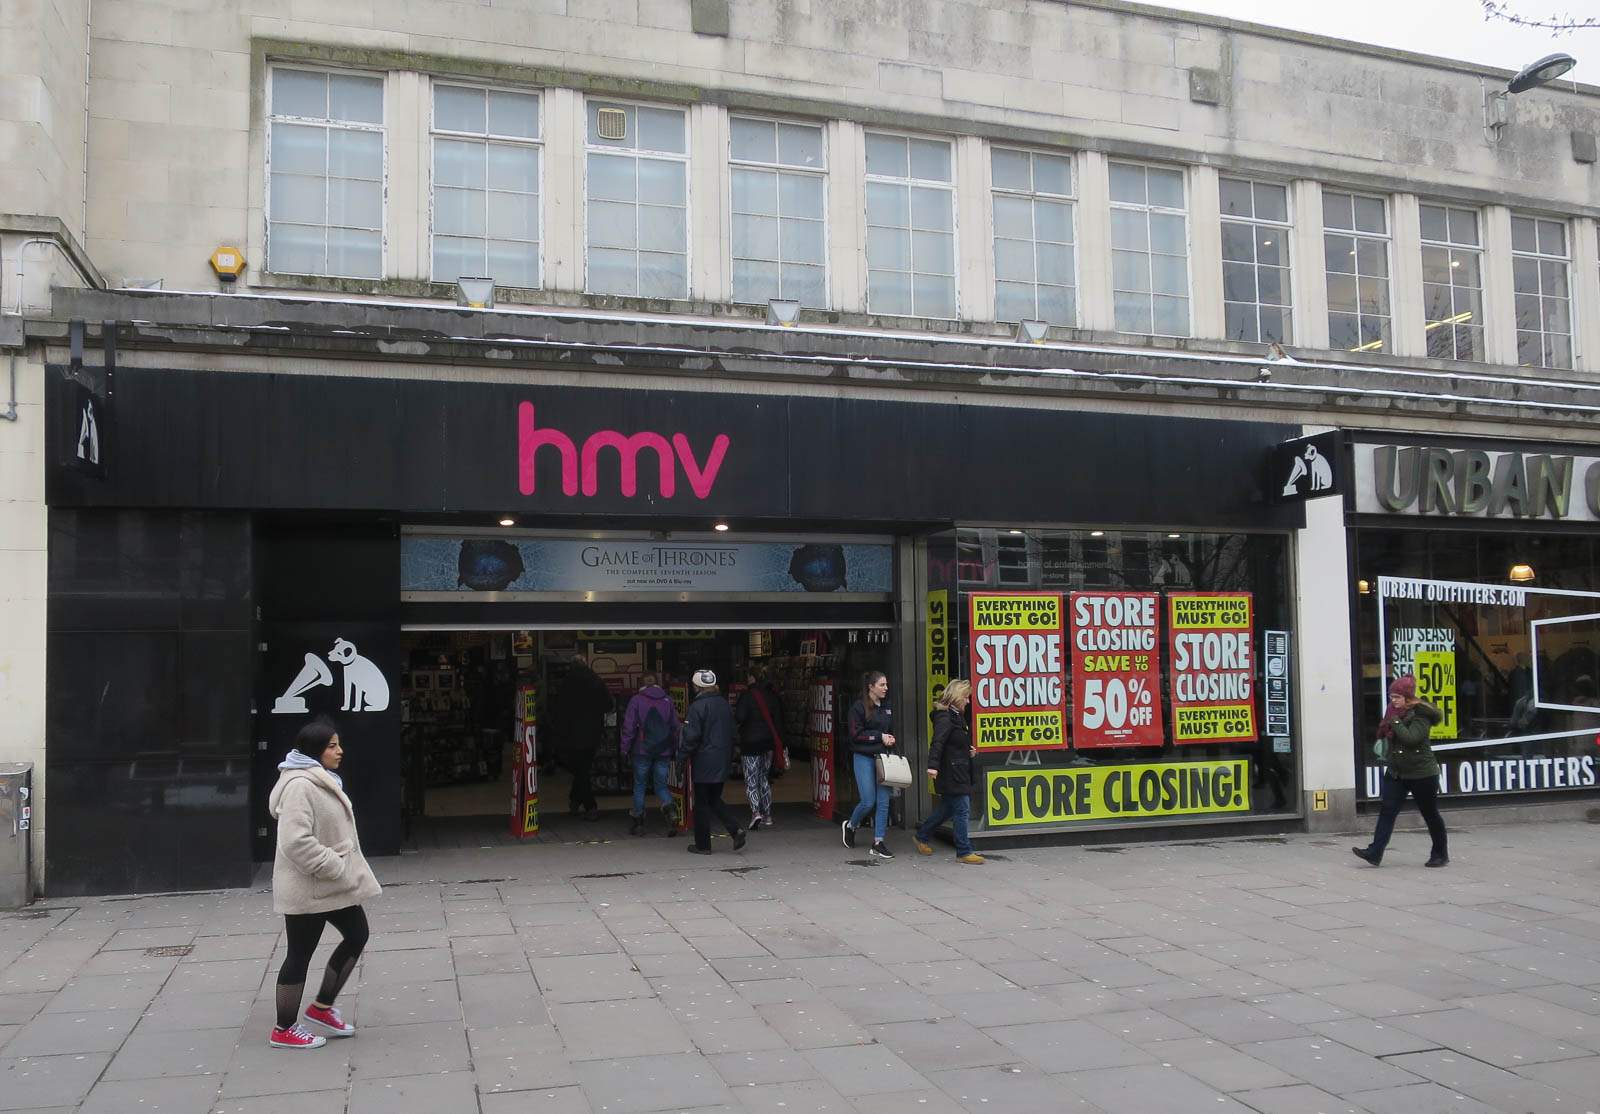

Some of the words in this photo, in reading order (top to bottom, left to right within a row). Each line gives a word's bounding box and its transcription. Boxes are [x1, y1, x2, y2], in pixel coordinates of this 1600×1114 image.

[518, 400, 730, 499] hmv
[1373, 445, 1574, 519] URBAN
[581, 546, 639, 567] GAME
[652, 547, 739, 568] THRONES
[1017, 559, 1041, 570] home
[1383, 580, 1423, 600] URBAN
[1428, 584, 1526, 607] OUTFITTERS.COM
[976, 600, 1056, 612] EVERYTHING
[1075, 596, 1155, 627] STORE
[1175, 600, 1247, 611] EVERYTHING
[978, 612, 1022, 626] MUST
[1028, 612, 1057, 626] GO!
[1177, 612, 1216, 625] MUST
[1221, 612, 1247, 625] GO!
[930, 600, 946, 676] STORE
[1076, 628, 1155, 651] CLOSING
[975, 633, 1061, 675] STORE
[1174, 632, 1250, 671] STORE
[1084, 655, 1131, 672] SAVE
[1135, 663, 1149, 671] TO
[1176, 672, 1250, 702] CLOSING
[1419, 662, 1454, 694] 50%
[976, 676, 1062, 708] CLOSING
[1083, 678, 1152, 729] 50%
[980, 715, 1059, 728] EVERYTHING
[1130, 706, 1153, 726] OFF
[1178, 709, 1249, 721] EVERYTHING
[981, 729, 1025, 743] MUST
[1031, 727, 1060, 742] GO!
[1180, 722, 1219, 735] MUST
[1224, 720, 1250, 734] GO!
[1459, 755, 1596, 793] OUTFITTERS
[991, 773, 1092, 821] STORE
[1103, 763, 1242, 813] CLOSING!
[1315, 791, 1327, 810] H
